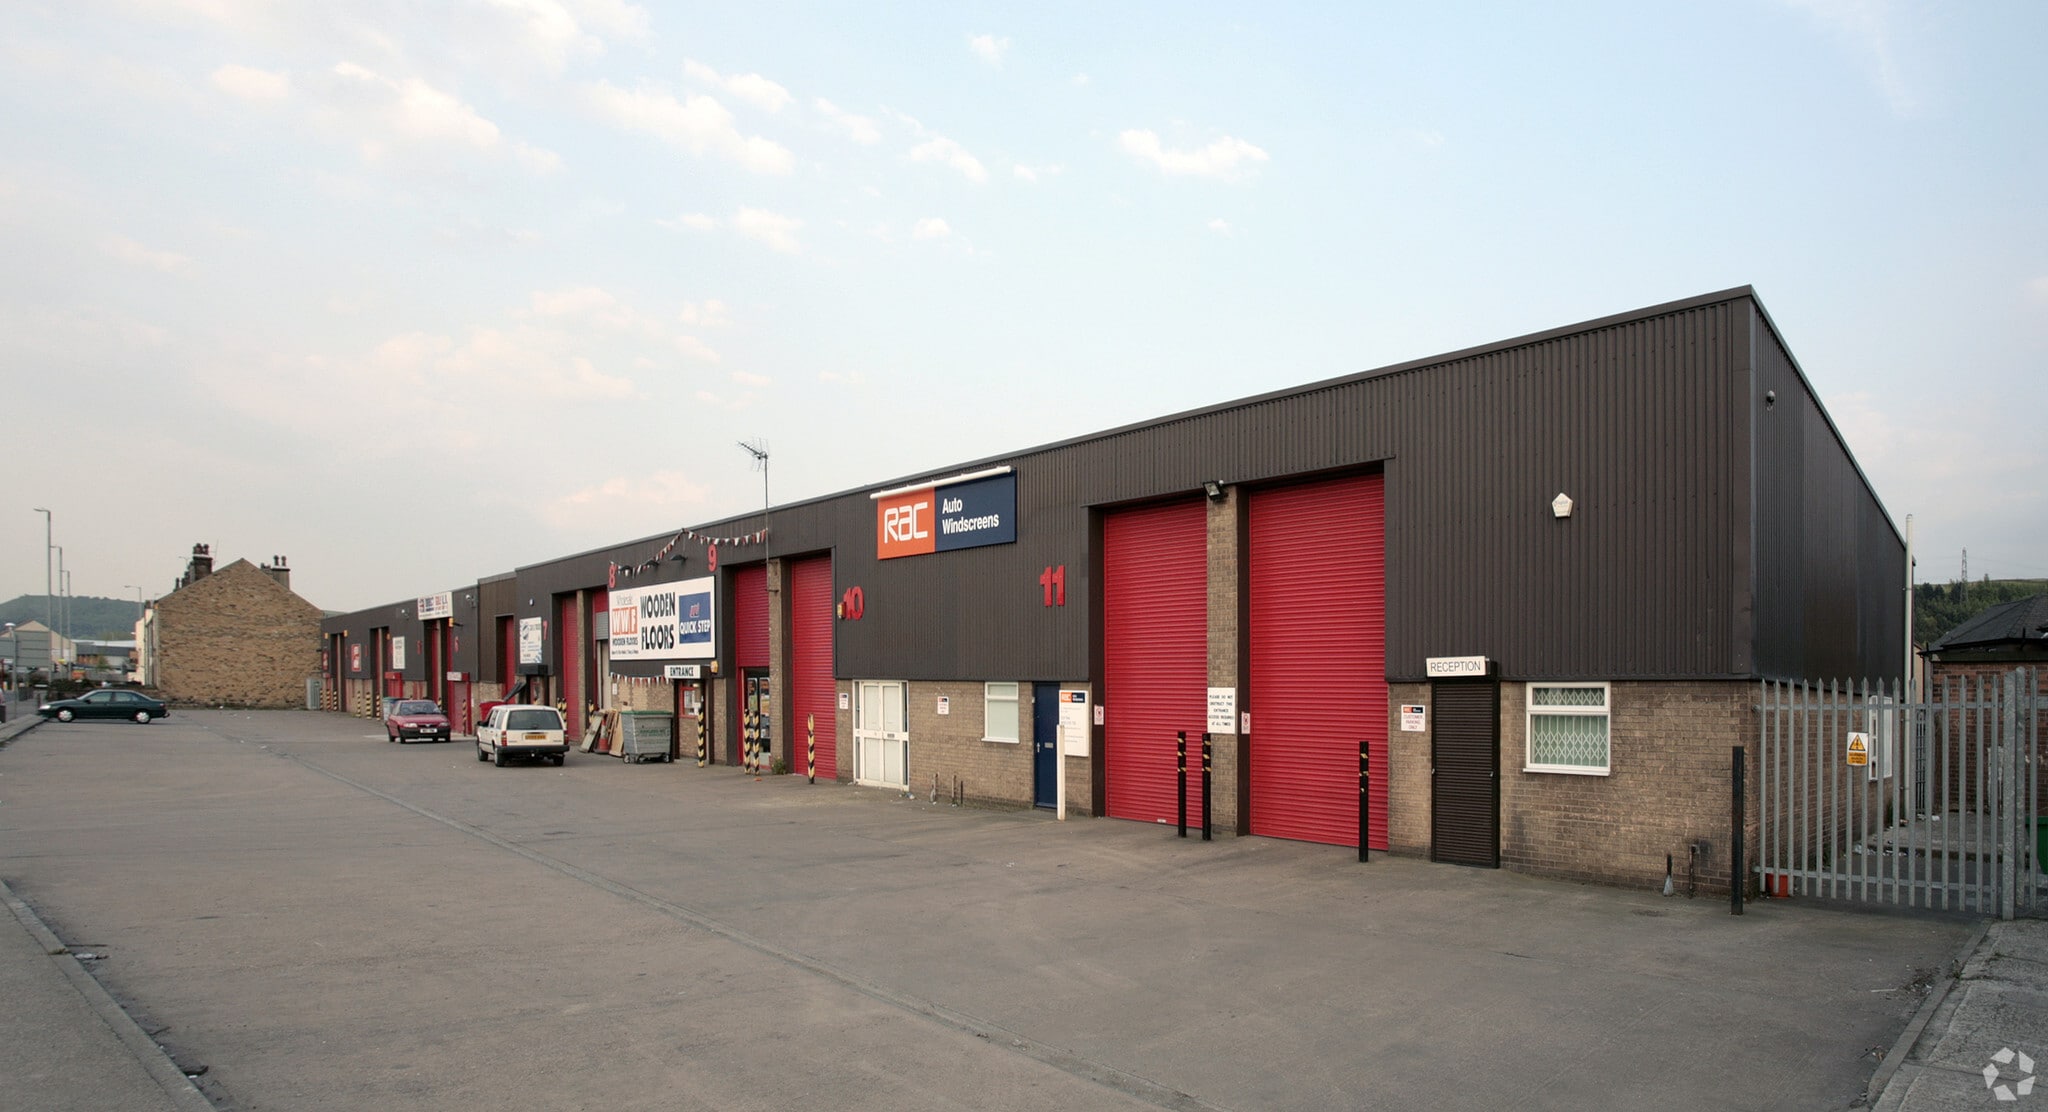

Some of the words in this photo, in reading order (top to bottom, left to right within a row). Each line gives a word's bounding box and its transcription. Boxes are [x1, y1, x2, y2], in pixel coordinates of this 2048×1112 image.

[942, 498, 963, 514] Auto
[884, 502, 928, 544] RAC
[942, 513, 1000, 535] Windscreens
[708, 543, 718, 572] 9
[608, 563, 617, 589] 8
[1039, 565, 1065, 607] 11
[640, 592, 676, 619] WOODEN
[842, 586, 864, 620] 10
[612, 607, 637, 635] WWF
[679, 620, 697, 635] QUICK
[697, 619, 711, 633] STEP
[641, 624, 675, 650] FLOORS
[669, 667, 694, 677] ENTRANCE
[1430, 660, 1481, 673] RECEPTION
